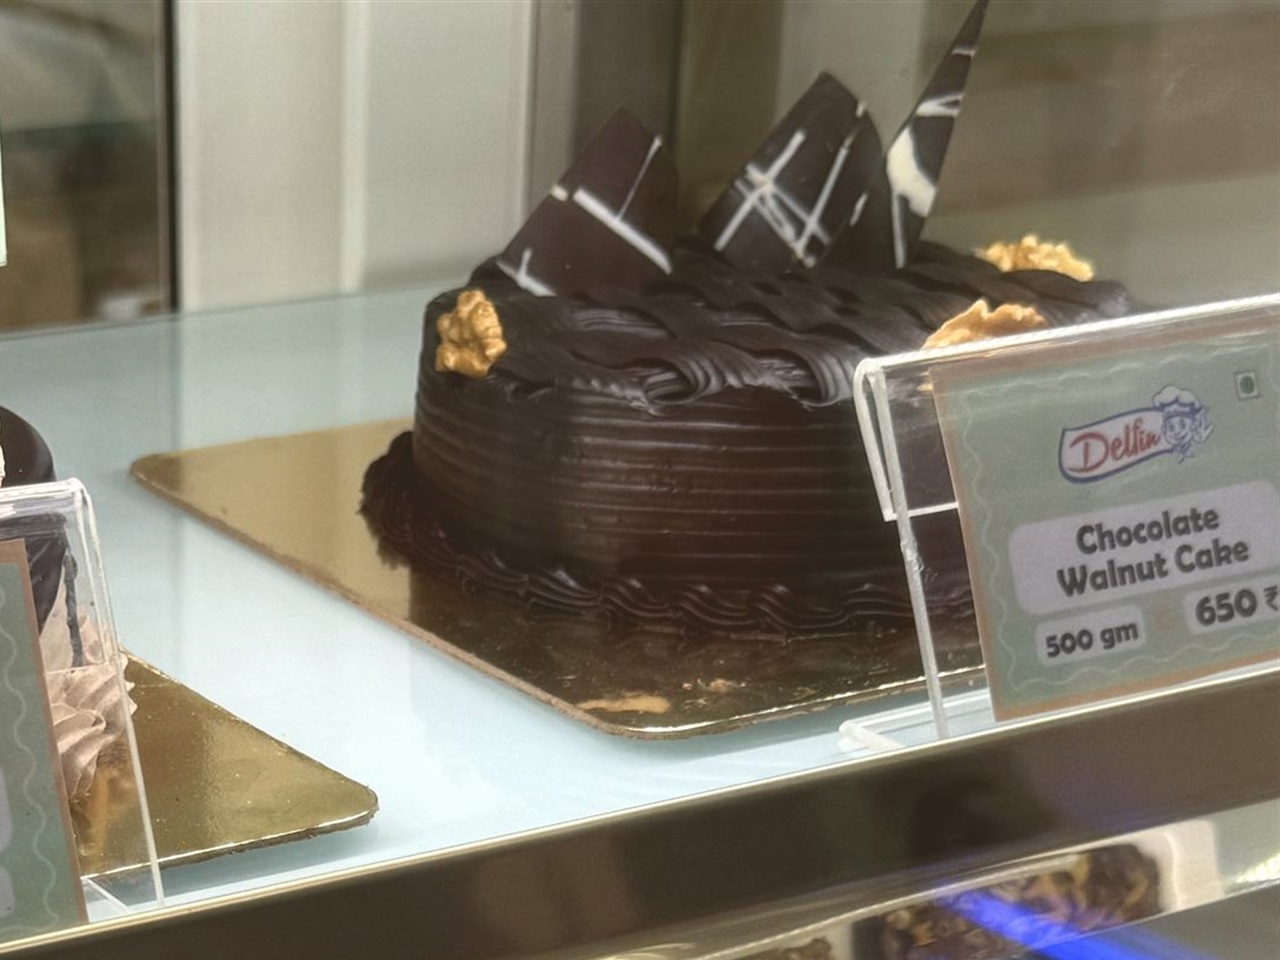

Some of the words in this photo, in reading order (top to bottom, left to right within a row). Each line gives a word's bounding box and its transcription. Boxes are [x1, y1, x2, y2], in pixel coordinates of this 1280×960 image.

[1069, 417, 1161, 473] Delfin
[1076, 508, 1219, 555] Chocolate
[1056, 553, 1168, 598] Walnut
[1173, 539, 1250, 573] Cake
[1194, 588, 1258, 626] 650
[1045, 627, 1094, 658] 500
[1099, 620, 1139, 648] gm
